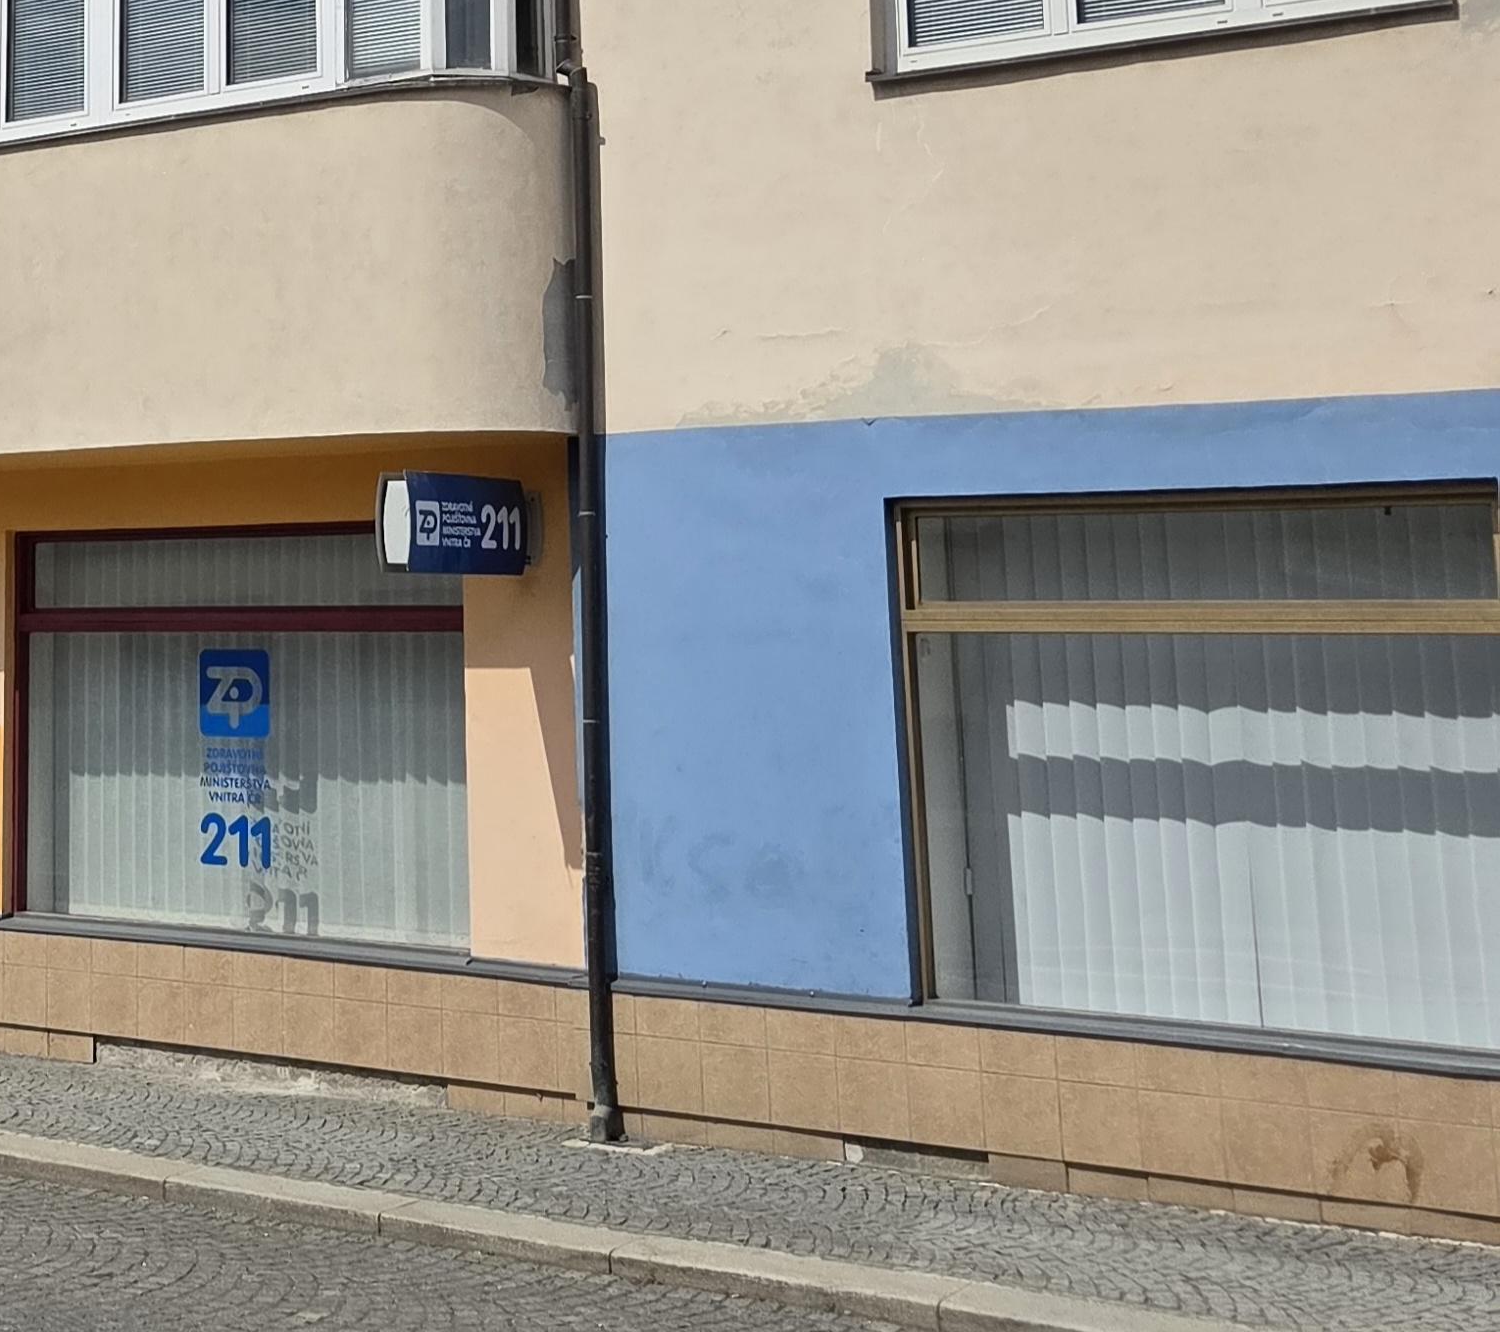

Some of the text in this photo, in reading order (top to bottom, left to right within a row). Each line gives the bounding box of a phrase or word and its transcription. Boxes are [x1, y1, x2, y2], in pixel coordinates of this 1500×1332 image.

[481, 504, 521, 550] 211
[200, 776, 271, 790] MINISTERSTVA
[209, 791, 245, 803] VNITRA
[200, 812, 271, 869] 211
